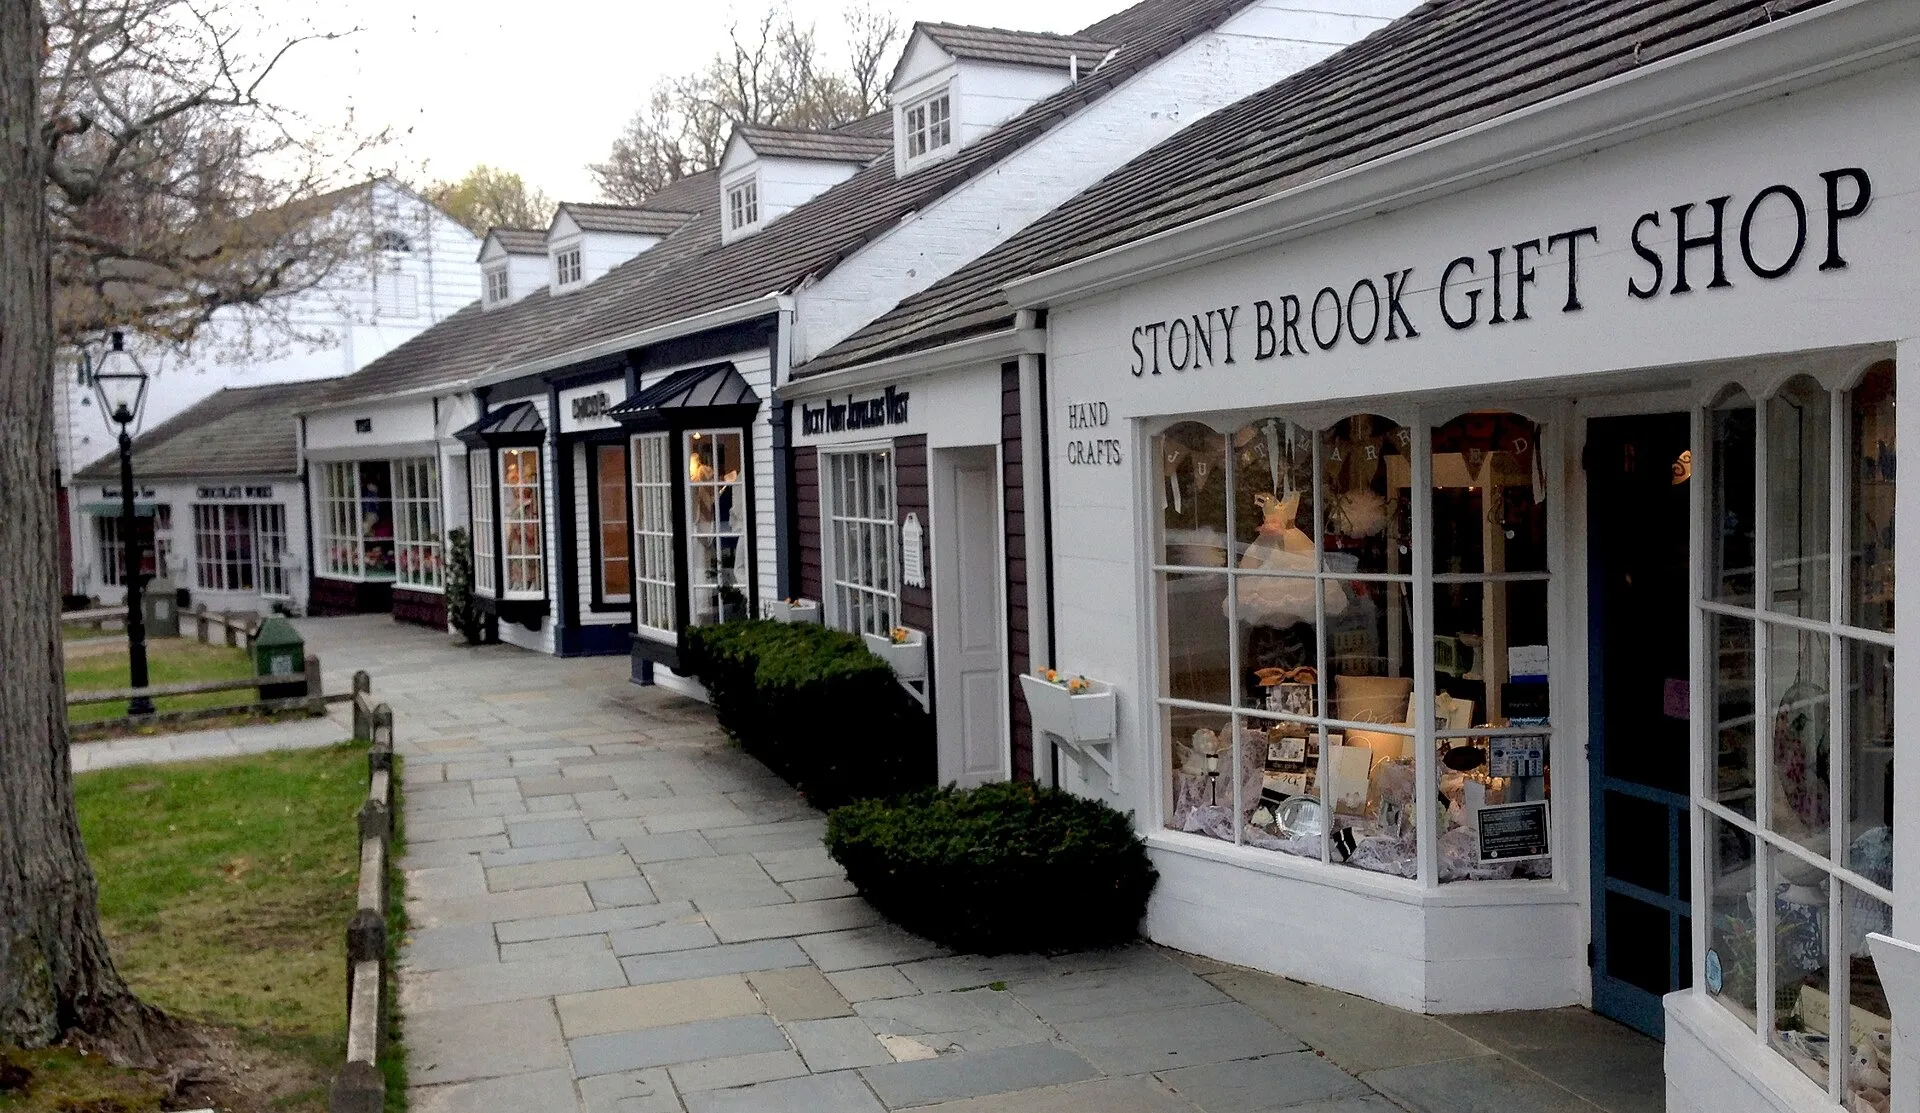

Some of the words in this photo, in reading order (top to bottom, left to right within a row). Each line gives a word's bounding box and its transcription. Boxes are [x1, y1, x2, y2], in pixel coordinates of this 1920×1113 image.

[1131, 305, 1240, 377] STONY
[1253, 267, 1421, 361] BROOK
[1439, 226, 1599, 331] GIFT
[1627, 167, 1873, 300] SHOP
[1068, 401, 1108, 429] HAND
[1067, 439, 1121, 465] CRAFTS
[1167, 442, 1267, 476] JUT
[1297, 430, 1528, 464] MARRED
